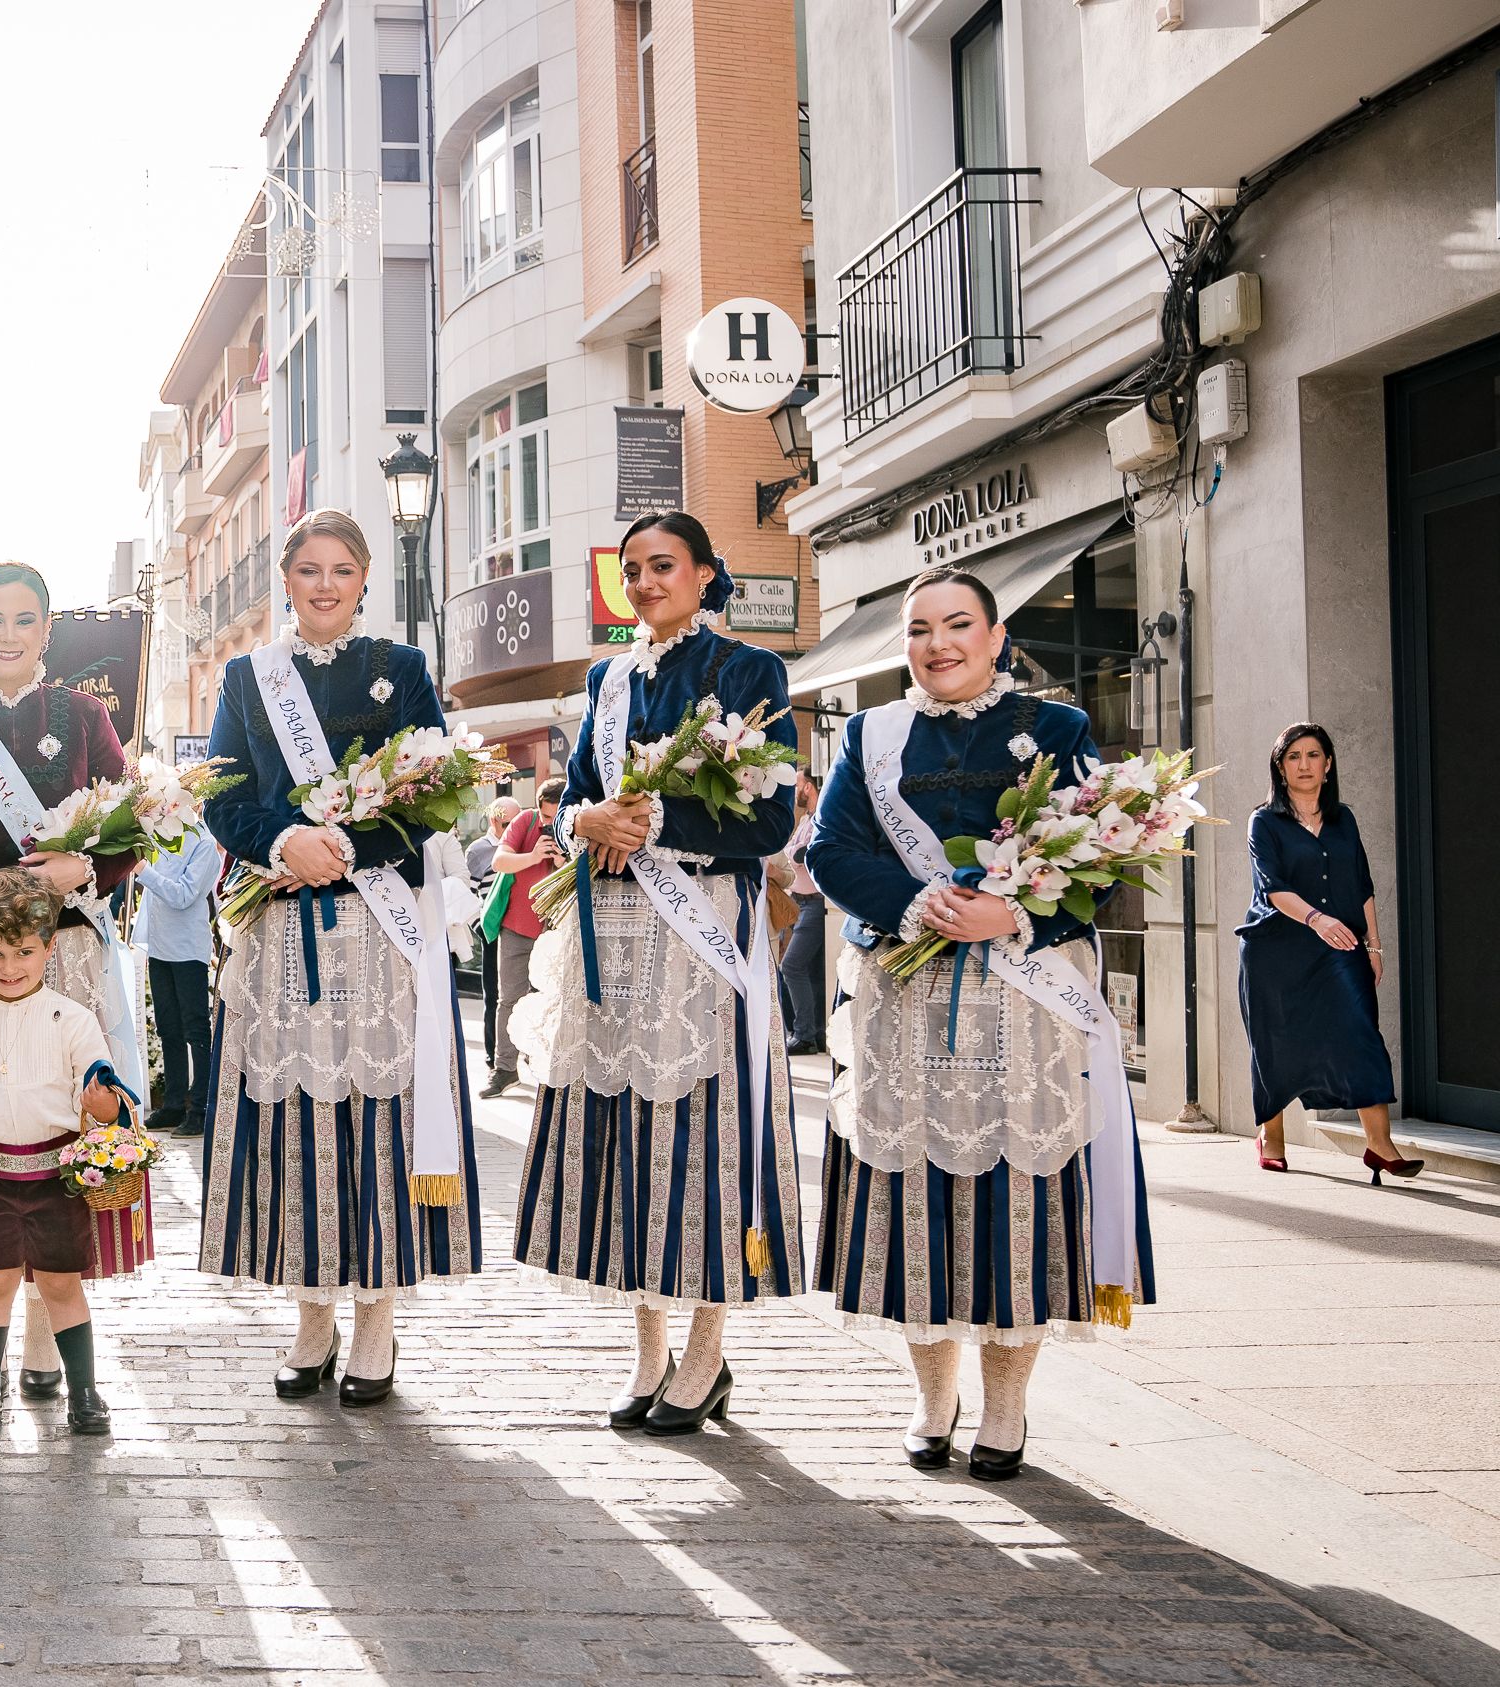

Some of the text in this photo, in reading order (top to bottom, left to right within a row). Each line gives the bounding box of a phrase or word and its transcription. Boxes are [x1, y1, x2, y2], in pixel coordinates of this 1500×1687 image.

[725, 313, 773, 361] H
[705, 371, 794, 384] DOÑA LOLA
[913, 463, 1033, 545] DOÑA LOLA
[924, 512, 1028, 564] BOUTIQUE
[730, 603, 794, 616] MONTENEGRO
[760, 584, 785, 596] Calle
[278, 698, 315, 759] DAMA
[602, 717, 617, 785] DAMA
[874, 784, 920, 855] DAMA
[631, 849, 689, 915] HONOR
[388, 906, 424, 946] 2026
[1059, 985, 1096, 1021] 2026
